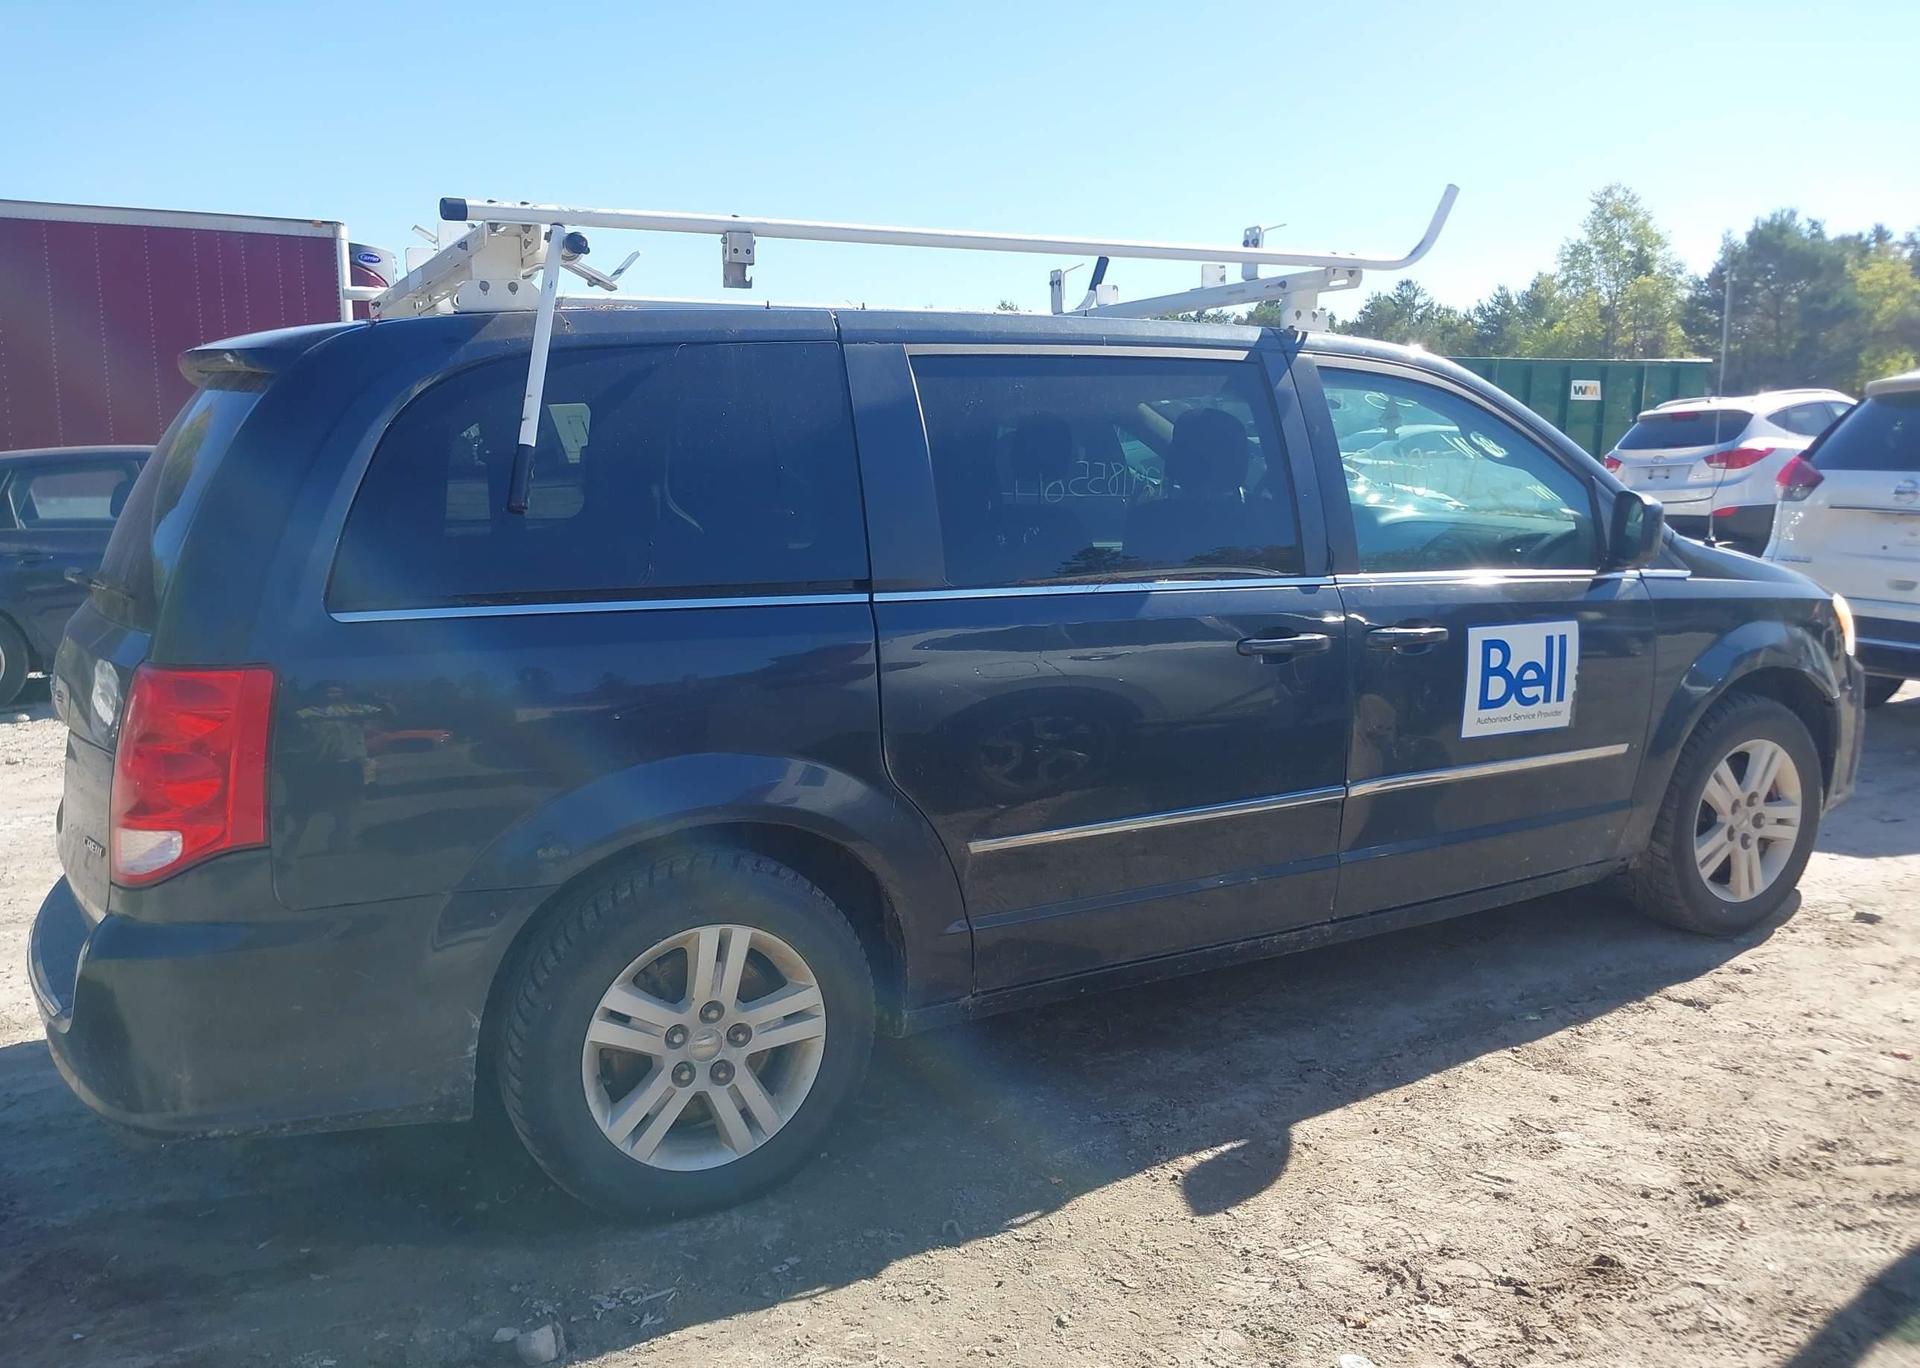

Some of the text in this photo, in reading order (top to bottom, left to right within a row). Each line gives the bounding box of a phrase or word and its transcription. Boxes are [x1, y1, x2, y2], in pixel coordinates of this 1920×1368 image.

[1573, 384, 1598, 396] WM
[1478, 634, 1567, 711] Bell
[1476, 709, 1563, 726] Authorized Service Provider
